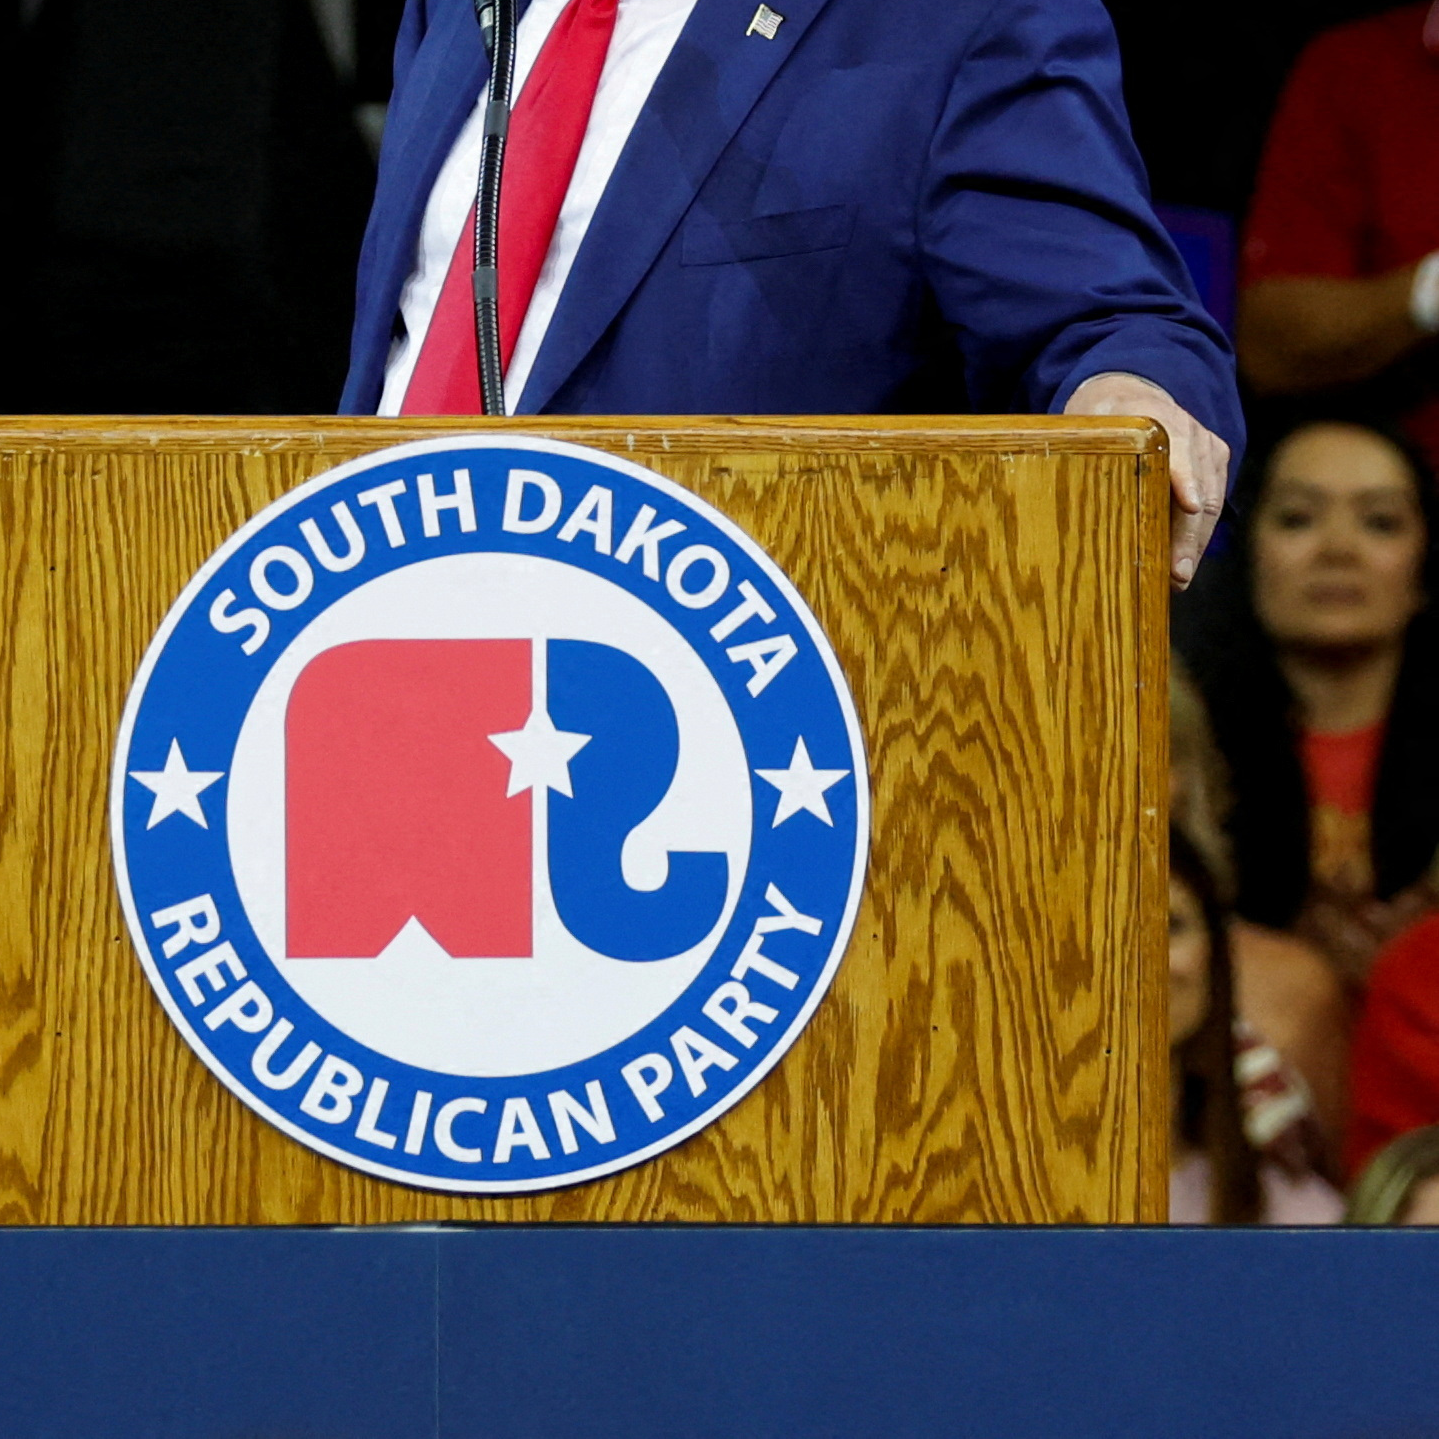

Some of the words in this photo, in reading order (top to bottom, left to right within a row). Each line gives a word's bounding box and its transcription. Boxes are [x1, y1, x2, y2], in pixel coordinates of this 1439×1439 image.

[209, 468, 478, 656] SOUTH
[501, 468, 799, 699] DAKOTA
[151, 892, 616, 1163] REPUBLICAN
[621, 880, 823, 1123] PARTY
